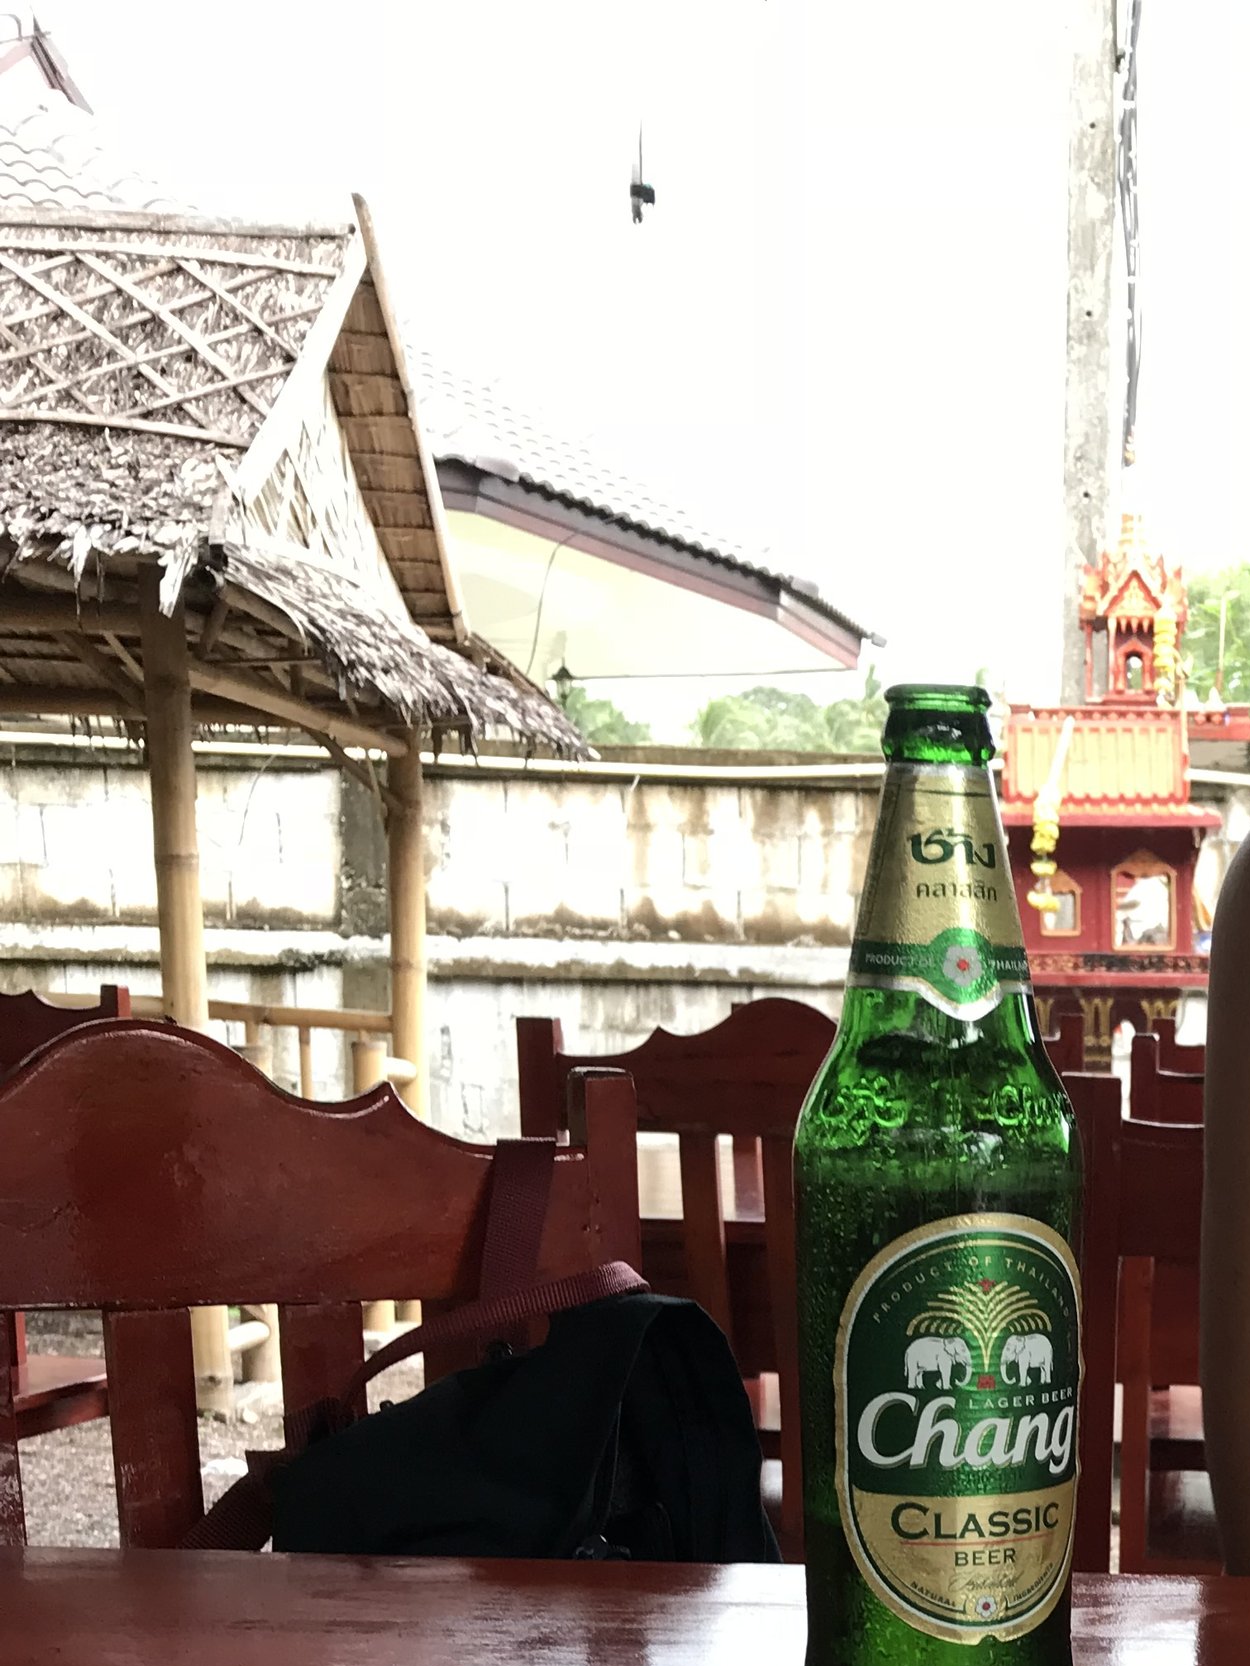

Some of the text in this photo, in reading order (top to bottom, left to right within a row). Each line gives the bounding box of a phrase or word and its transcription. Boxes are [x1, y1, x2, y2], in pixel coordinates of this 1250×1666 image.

[873, 1256, 1069, 1324] PRODUCT OF THAILAND
[969, 1386, 1073, 1409] LAGER BEER
[857, 1391, 1075, 1474] Chang
[891, 1502, 1059, 1540] CLASSIC
[955, 1548, 1016, 1567] BEER
